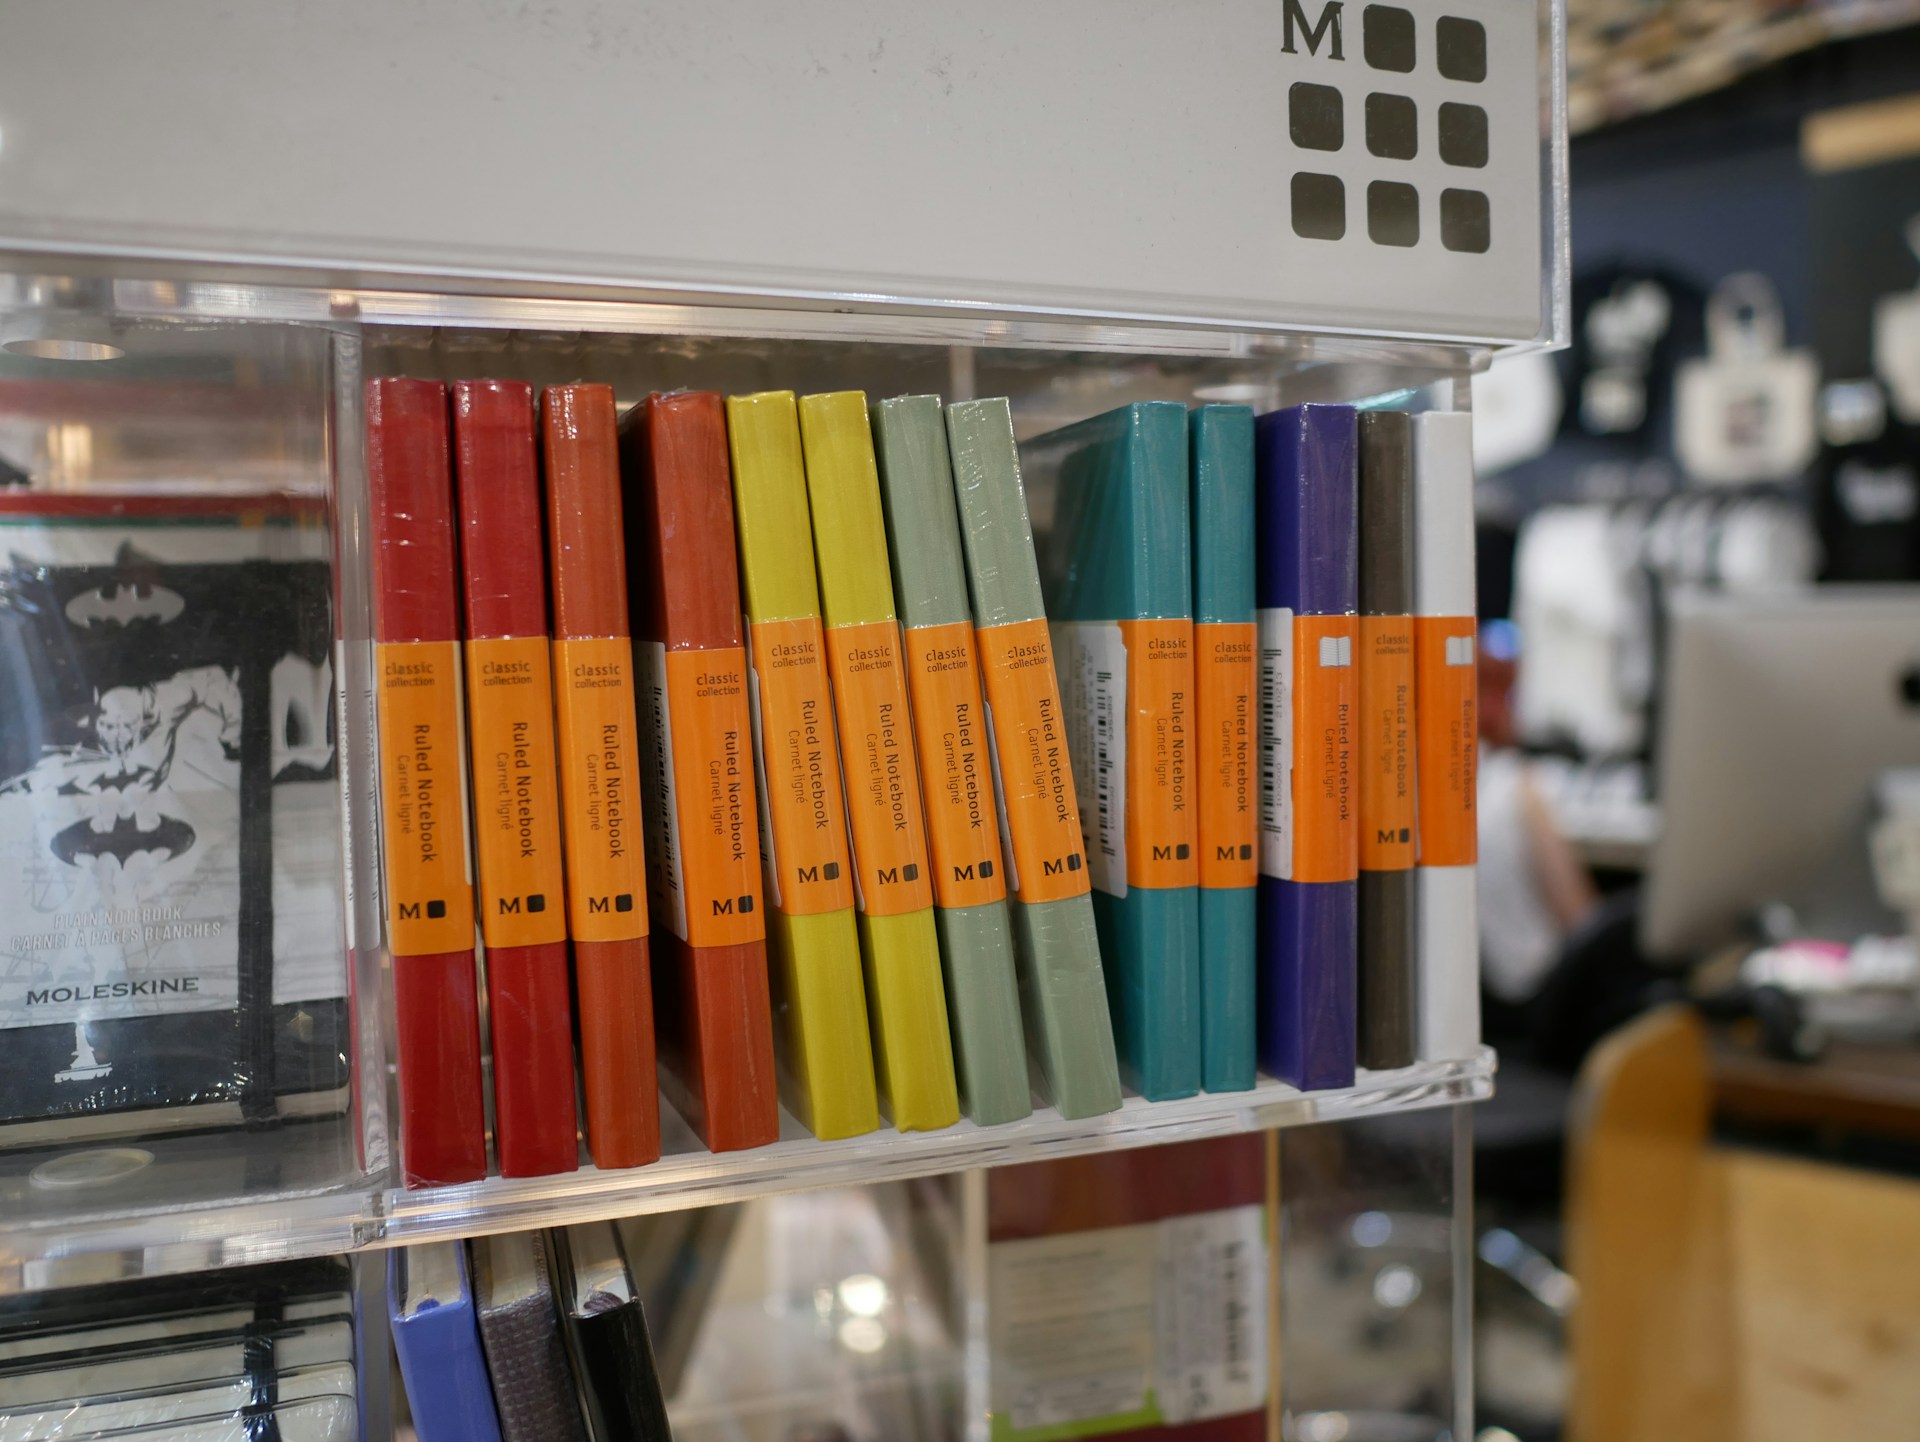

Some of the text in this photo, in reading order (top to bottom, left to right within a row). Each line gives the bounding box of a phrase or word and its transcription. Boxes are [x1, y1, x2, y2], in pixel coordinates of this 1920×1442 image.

[1281, 0, 1345, 61] M
[771, 642, 815, 657] classic
[1007, 642, 1046, 658] classic
[1148, 638, 1187, 649] classic
[1215, 641, 1252, 653] classic
[772, 656, 816, 668] collection
[848, 646, 891, 661] classic
[926, 647, 966, 661] classic
[1008, 655, 1048, 670] collection
[1148, 651, 1187, 660] collection
[1215, 655, 1252, 664] collection
[385, 662, 434, 675] classic
[482, 661, 531, 674] classic
[575, 664, 620, 677] classic
[849, 659, 892, 672] collection
[926, 660, 968, 673] collection
[385, 677, 435, 687] collection
[483, 676, 532, 687] collection
[575, 678, 622, 688] collection
[696, 672, 740, 686] classic
[696, 686, 740, 697] collection
[1157, 718, 1167, 758] Carnet
[1221, 720, 1232, 760] Carnet
[1324, 728, 1335, 766] Carnet
[1396, 685, 1407, 798] Ruled Notebook
[788, 730, 802, 771] Carnet
[866, 733, 880, 774] Carnet
[943, 733, 957, 773] Carnet
[1027, 728, 1042, 769] Carnet
[1171, 692, 1185, 812] Ruled Notebook
[1236, 695, 1249, 812] Ruled Notebook
[1463, 701, 1472, 811] Ruled Notebook
[802, 700, 827, 829] Ruled Notebook
[879, 704, 906, 831] Ruled Notebook
[956, 703, 983, 829] Ruled Notebook
[1039, 698, 1069, 823] Ruled Notebook
[1338, 704, 1349, 821] Ruled Notebook
[397, 755, 411, 801] Carnet
[496, 752, 509, 797] Carnet
[586, 754, 600, 797] Carnet
[709, 760, 722, 802] Carnet
[414, 724, 437, 862] Ruled Notebook
[512, 722, 536, 858] Ruled Notebook
[603, 724, 625, 858] Ruled Notebook
[724, 731, 746, 861] Ruled Notebook
[1377, 829, 1395, 843] M
[1152, 846, 1171, 861] M
[1216, 846, 1235, 861] M
[797, 866, 819, 884] M
[954, 865, 974, 882] M
[1043, 858, 1064, 876] M
[877, 868, 898, 885] M
[399, 903, 421, 920] M
[499, 897, 521, 914] M
[589, 897, 610, 913] M
[712, 899, 733, 916] M
[54, 905, 183, 929] PLAIN NOTEBOOK
[11, 933, 72, 952] CARNET
[91, 928, 140, 946] PAGES
[144, 921, 223, 941] BLANCHES
[26, 977, 200, 1006] MOLESKINE
